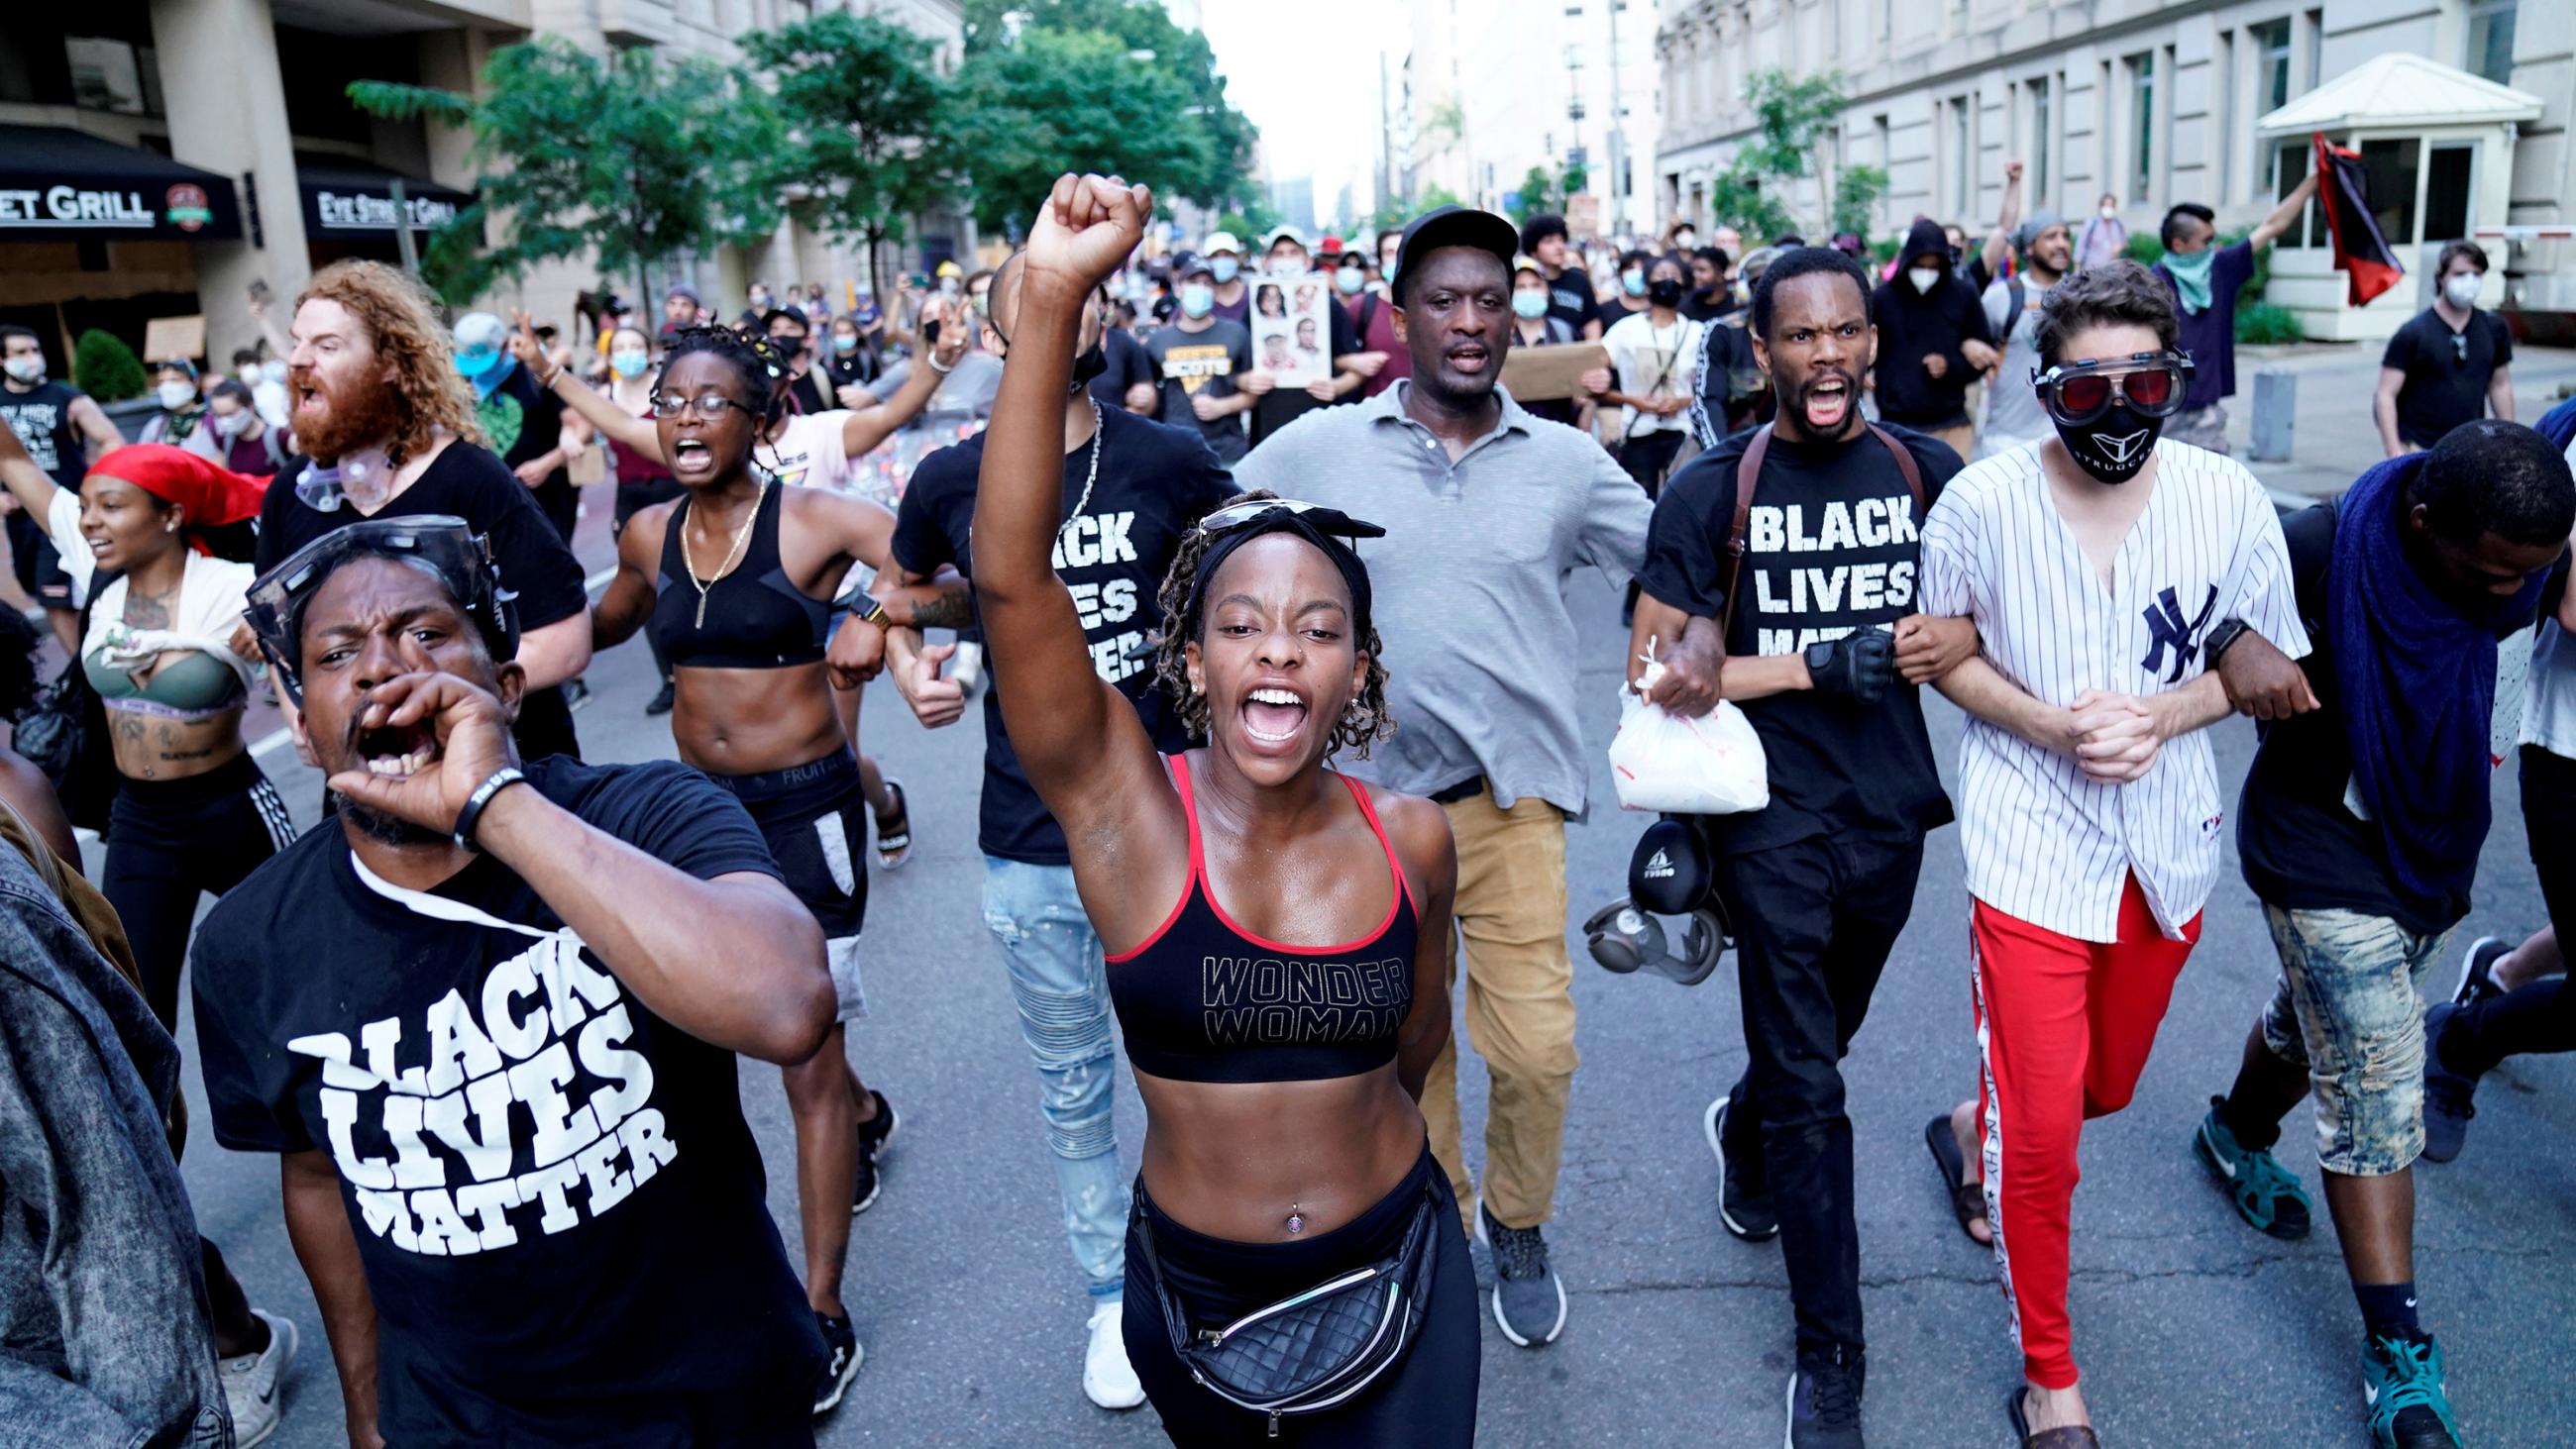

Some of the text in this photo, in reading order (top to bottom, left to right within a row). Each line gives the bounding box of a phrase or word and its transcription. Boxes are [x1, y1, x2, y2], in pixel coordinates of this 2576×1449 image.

[47, 185, 155, 221] GRILL
[356, 193, 414, 224] STRET
[1750, 495, 1919, 552] BLACK
[1755, 562, 1915, 613] LIVES
[783, 761, 826, 785] FRUIT
[1203, 956, 1410, 1007] WONDER
[319, 1003, 654, 1190] LIVES
[356, 1107, 678, 1257] MATTER
